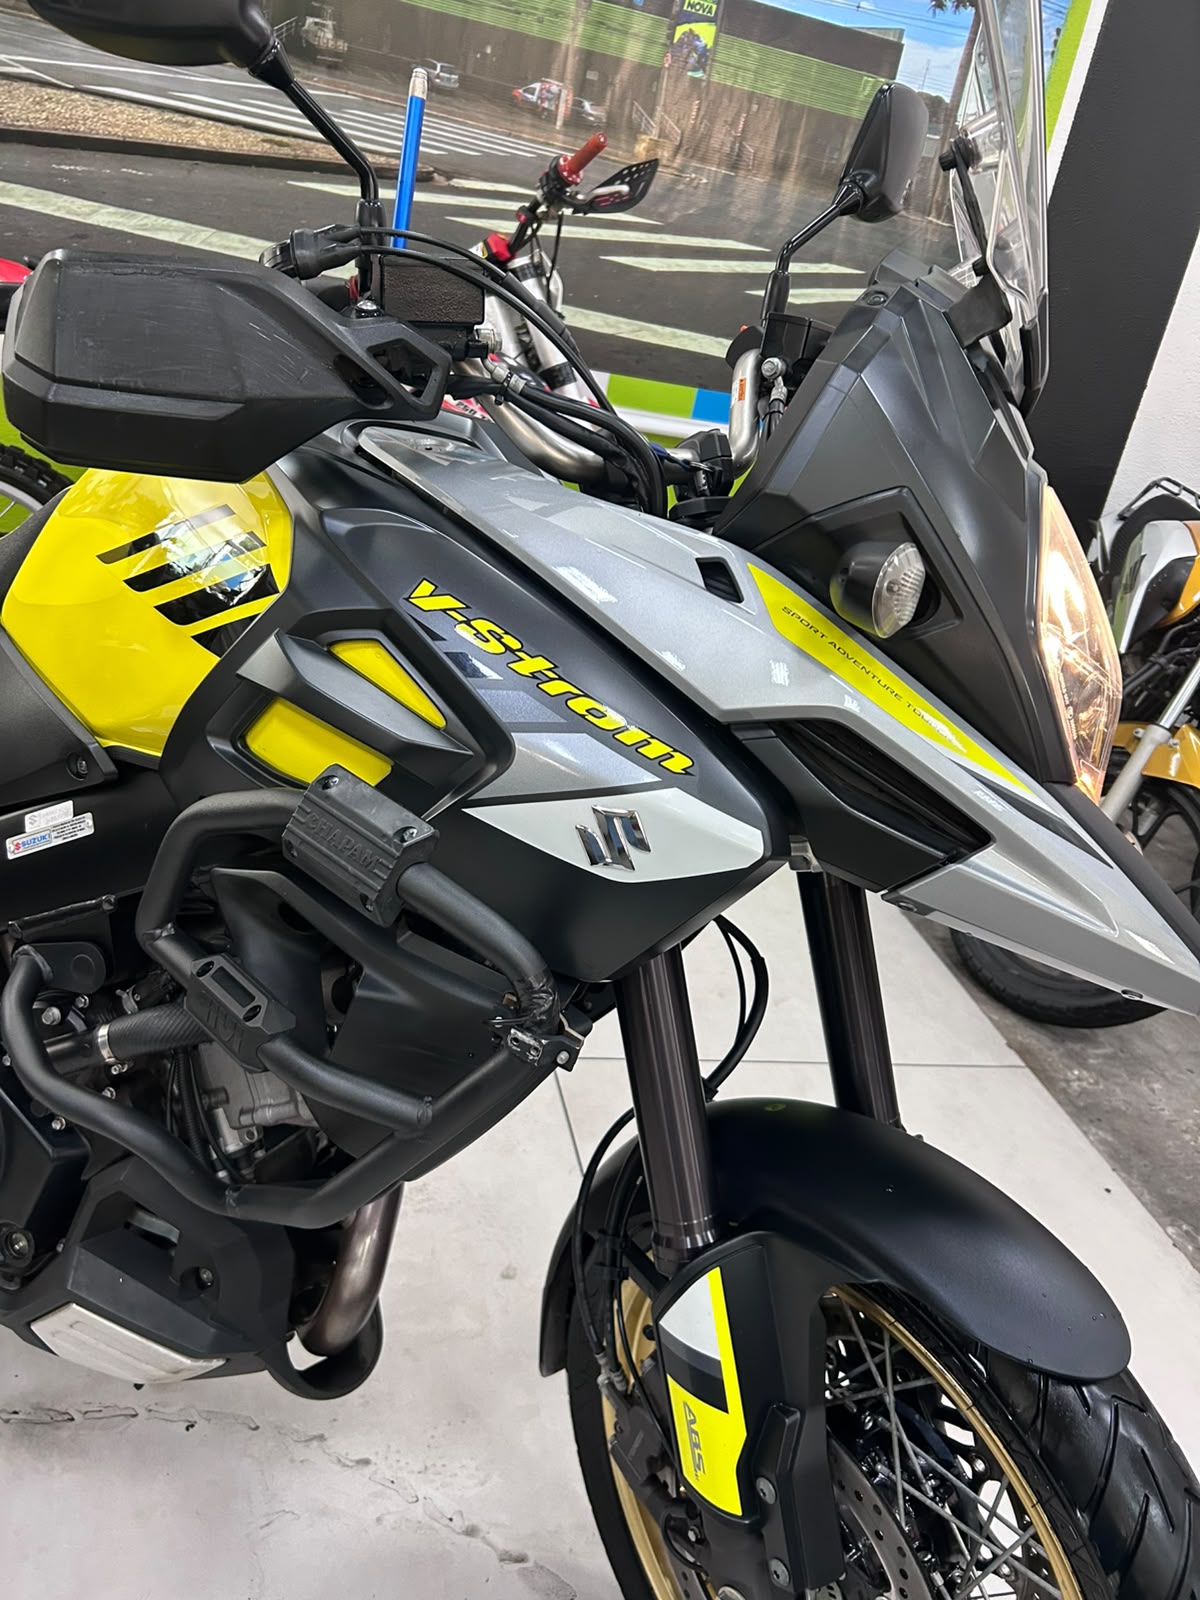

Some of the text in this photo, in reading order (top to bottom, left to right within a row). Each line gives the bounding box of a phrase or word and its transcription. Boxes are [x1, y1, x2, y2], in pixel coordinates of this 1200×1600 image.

[686, 0, 713, 16] NOVA
[403, 577, 696, 777] V-Strom
[781, 605, 952, 743] SPORT ADVENTURE TOU
[21, 832, 51, 849] SUZUKI
[304, 812, 381, 870] CHAPAM
[683, 1400, 706, 1476] ABS
